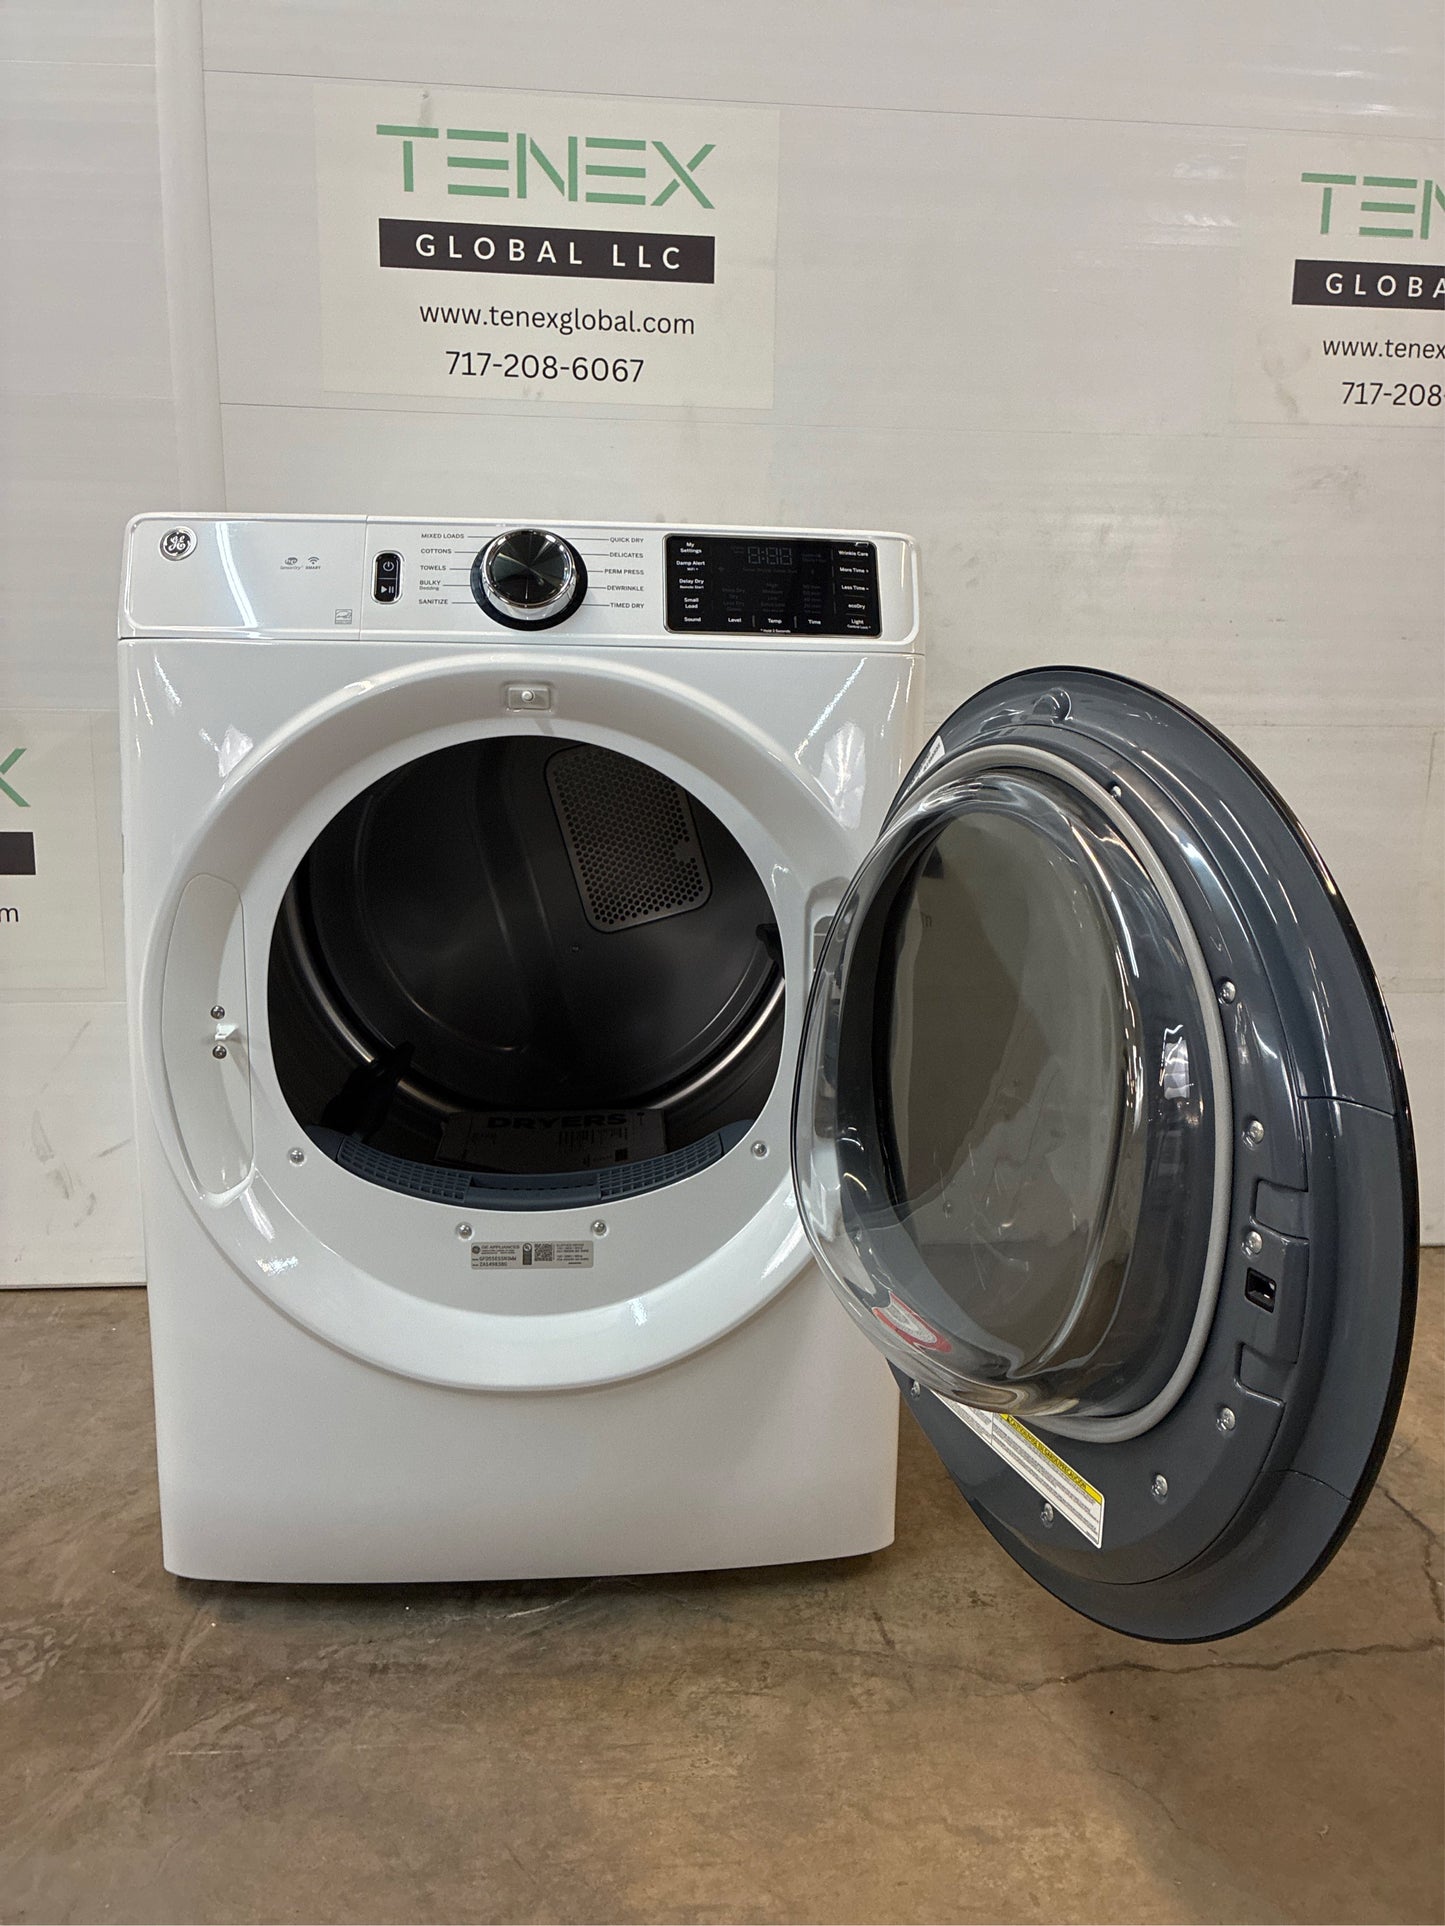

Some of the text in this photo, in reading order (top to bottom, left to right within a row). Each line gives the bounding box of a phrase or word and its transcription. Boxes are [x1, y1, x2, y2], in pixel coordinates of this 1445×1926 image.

[376, 124, 716, 210] TENEX
[415, 233, 682, 270] GLOBAL LLC
[419, 302, 696, 337] www.tenexglobal.com
[445, 351, 645, 384] 717-208-6067
[487, 1113, 627, 1129] DRYERS
